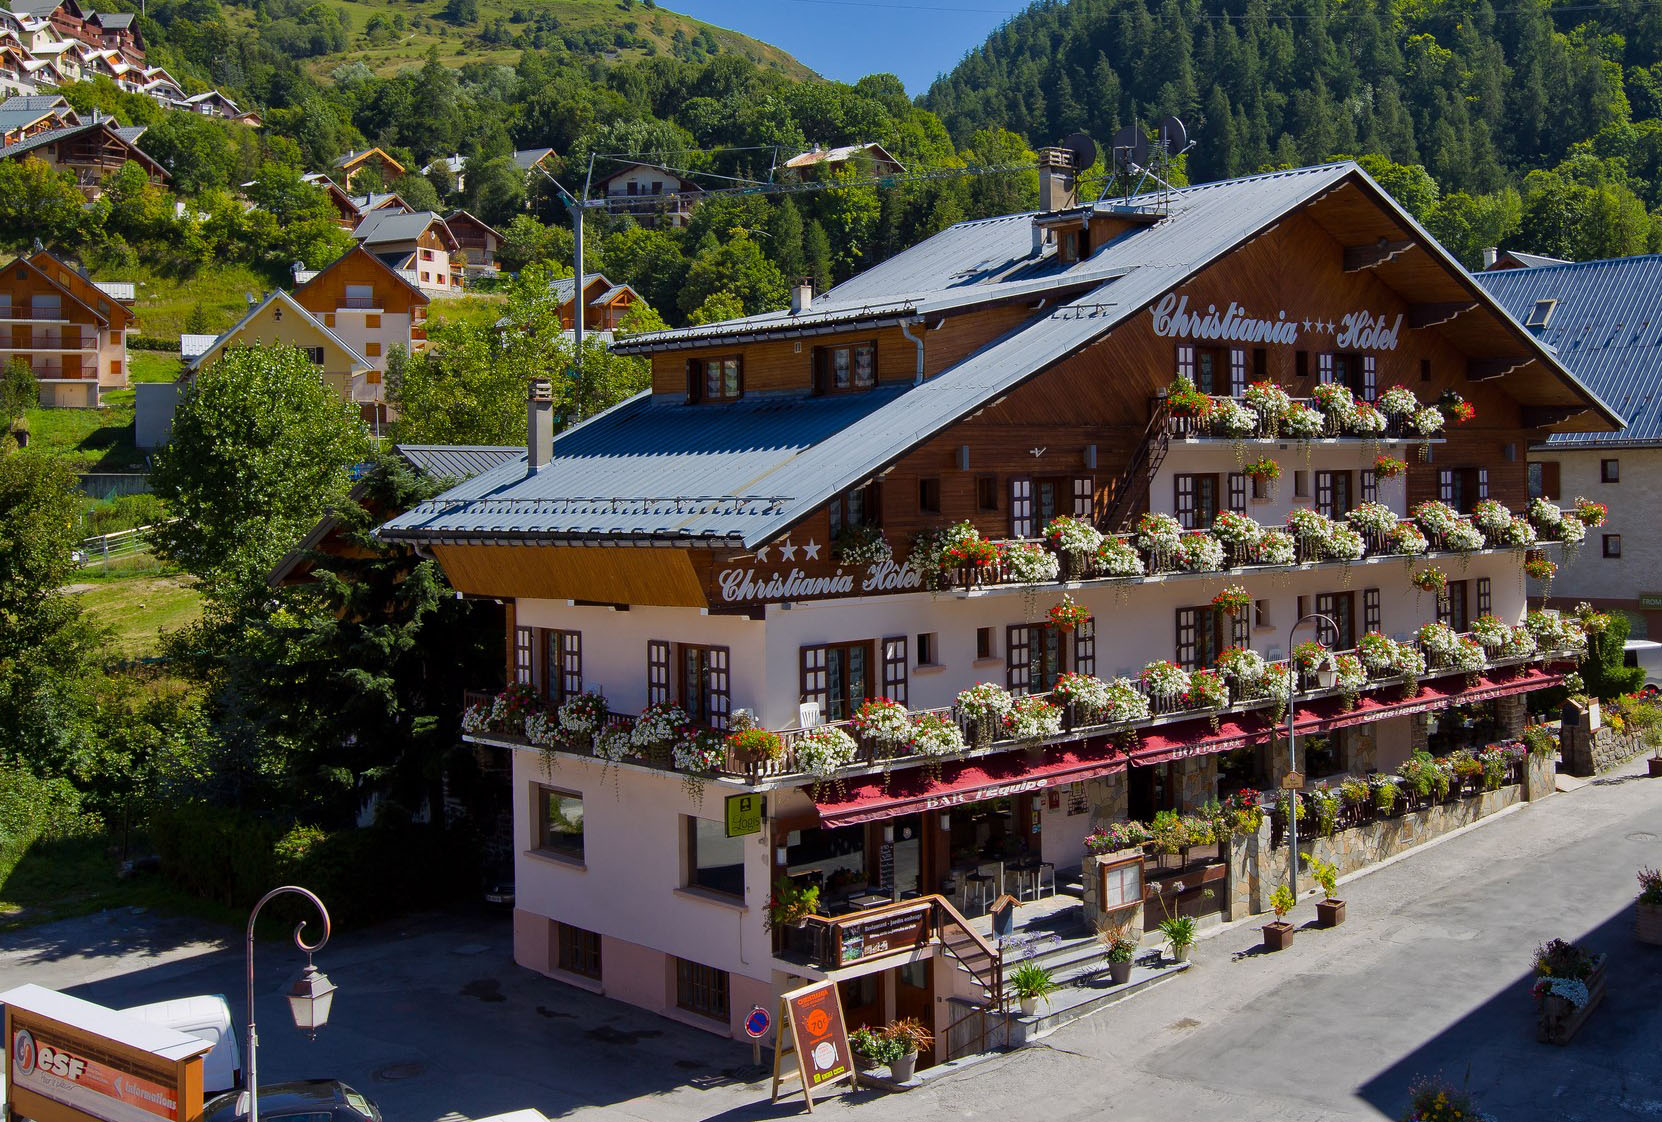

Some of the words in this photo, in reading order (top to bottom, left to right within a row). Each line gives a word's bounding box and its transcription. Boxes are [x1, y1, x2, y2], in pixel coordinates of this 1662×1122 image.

[1149, 292, 1297, 344] Christiania
[1336, 310, 1404, 350] Hôtel
[719, 568, 853, 601] Christiania
[125, 1080, 177, 1110] Informations
